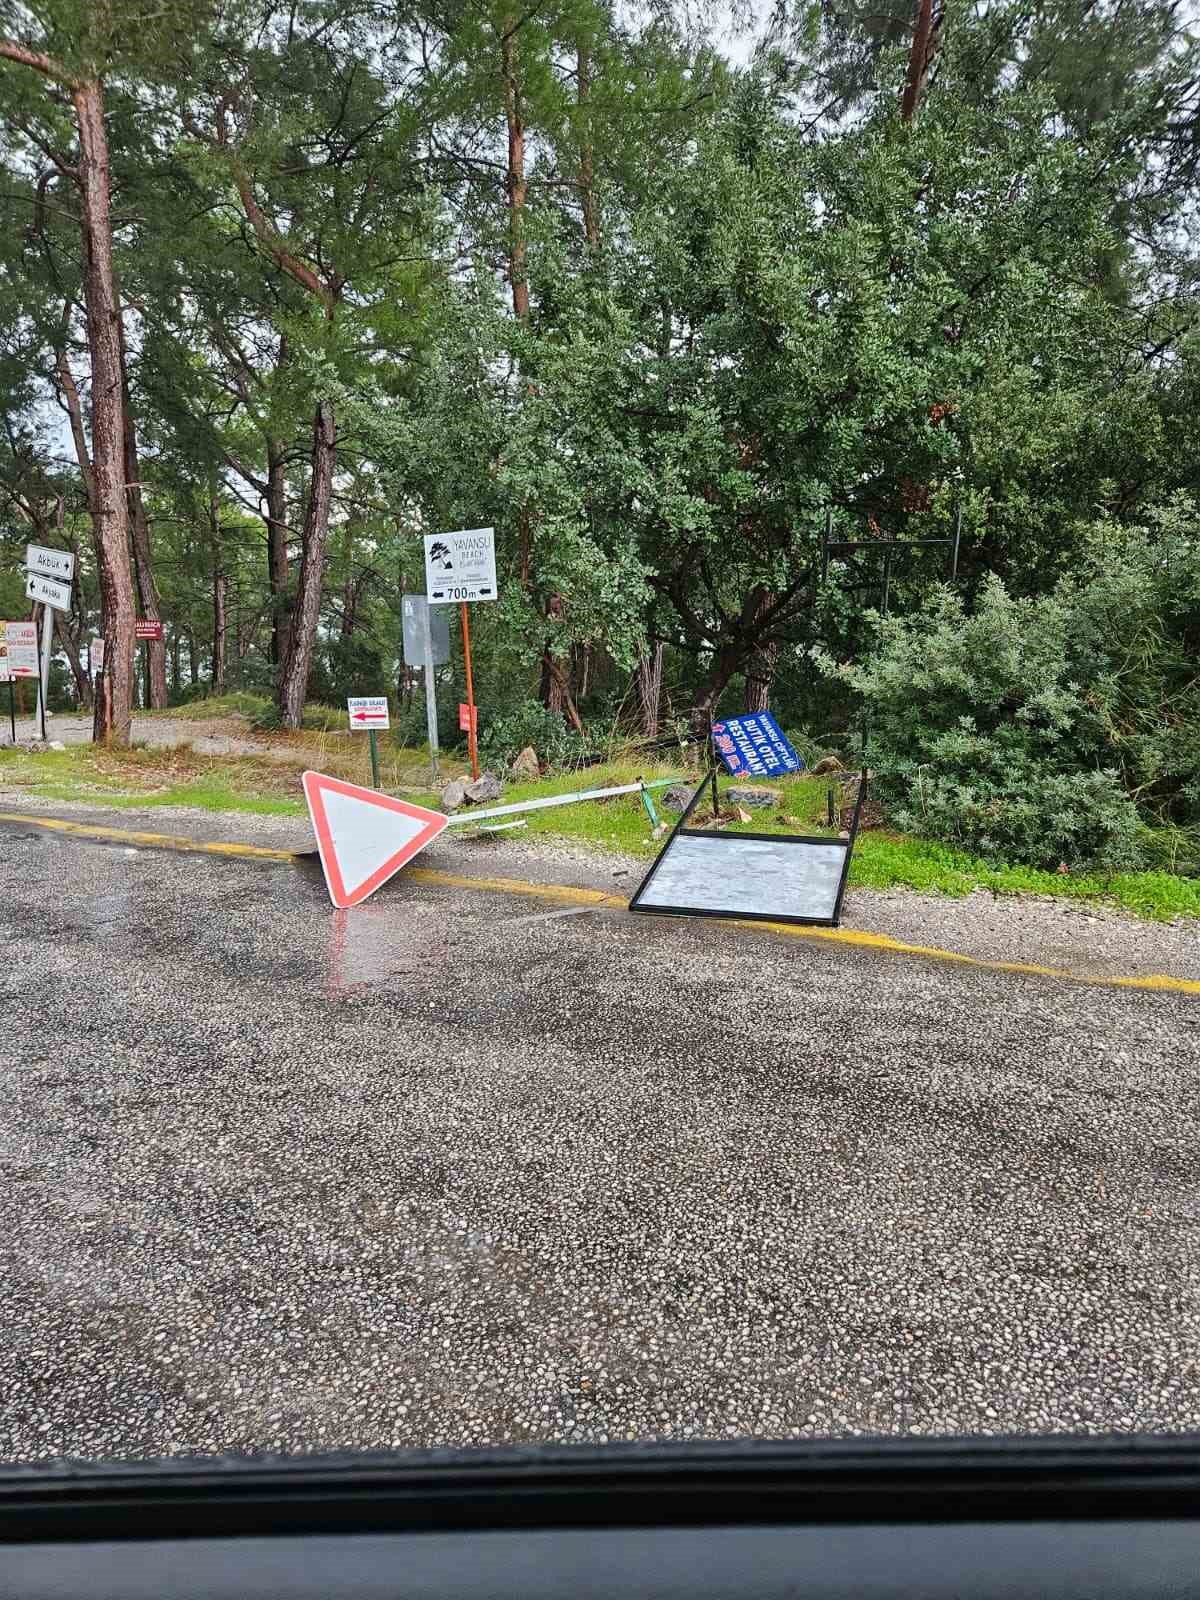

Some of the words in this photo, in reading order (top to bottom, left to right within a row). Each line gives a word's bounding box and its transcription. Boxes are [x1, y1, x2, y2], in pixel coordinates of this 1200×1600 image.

[453, 535, 491, 551] YAVANSU
[726, 719, 768, 775] RESTAURANT
[758, 746, 780, 769] OTEL
